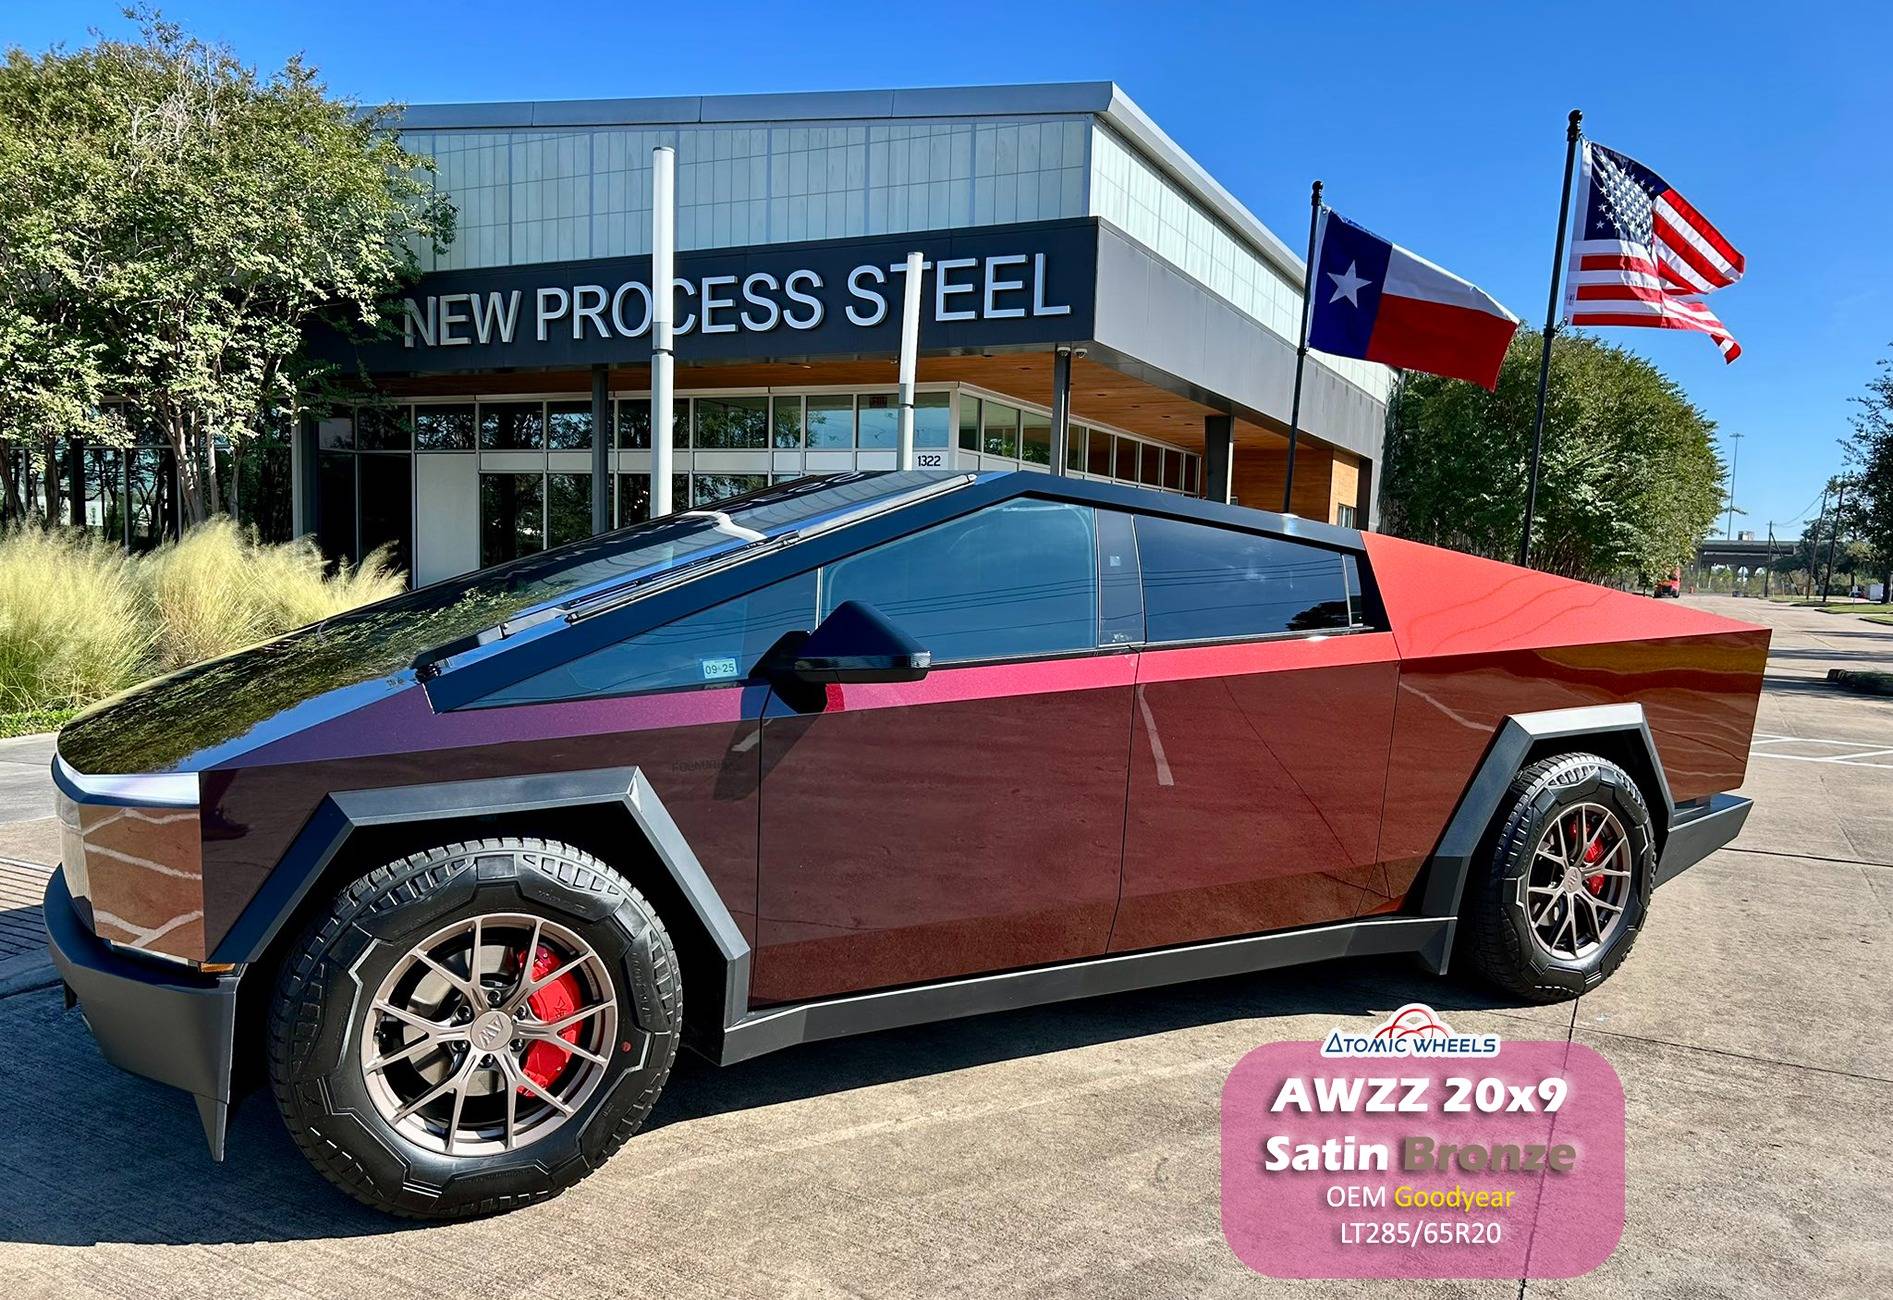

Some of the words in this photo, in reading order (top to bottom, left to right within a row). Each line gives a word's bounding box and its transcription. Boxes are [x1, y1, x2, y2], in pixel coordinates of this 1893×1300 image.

[404, 290, 522, 348] NEW
[536, 269, 825, 342] PROCESS
[917, 455, 941, 467] 1322
